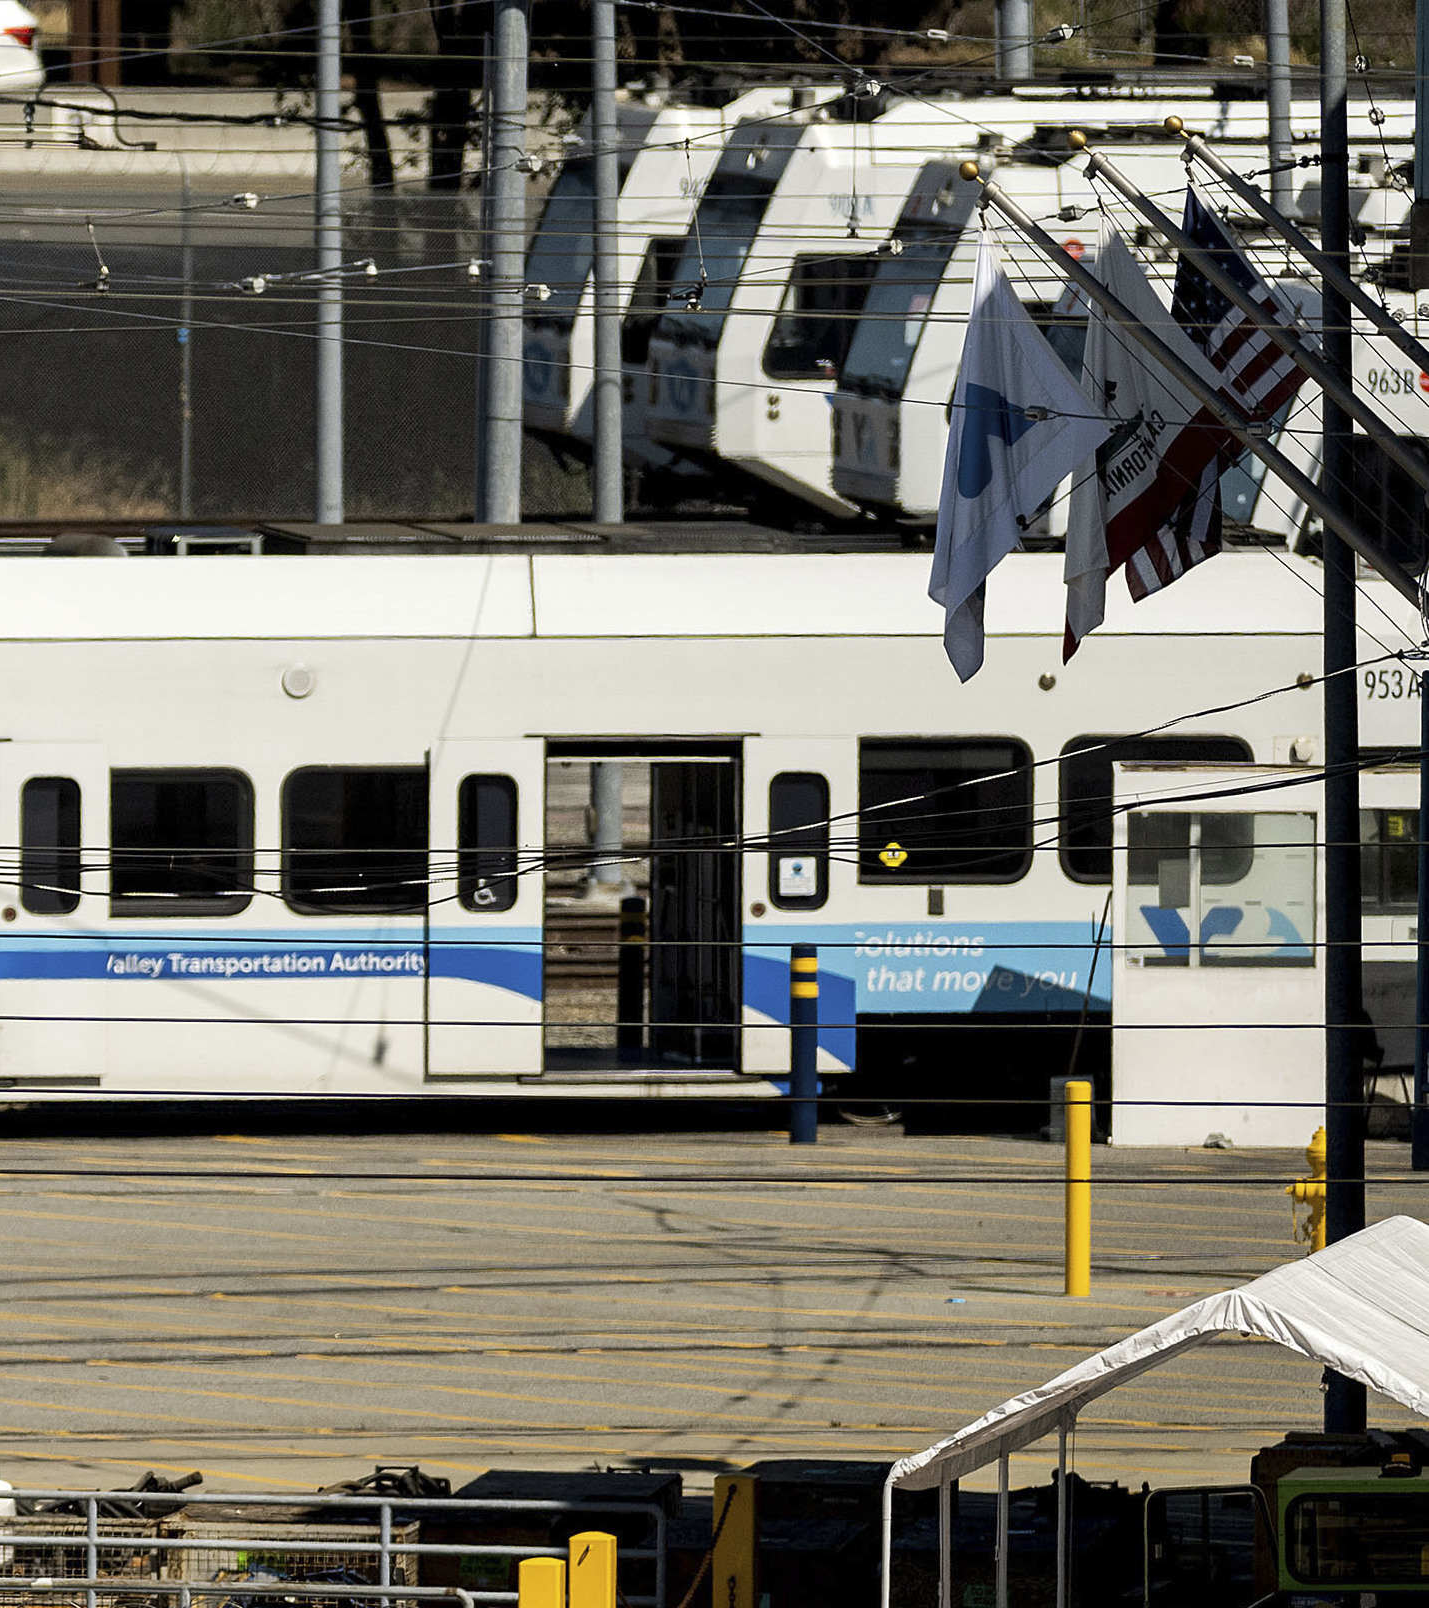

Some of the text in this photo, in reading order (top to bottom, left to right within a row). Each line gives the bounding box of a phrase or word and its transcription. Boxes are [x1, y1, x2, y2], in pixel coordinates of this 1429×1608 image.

[1368, 368, 1414, 394] 963B
[1365, 670, 1421, 699] 953A
[167, 952, 326, 976] Transportation
[329, 951, 427, 975] Authority
[867, 964, 1078, 997] that move you
